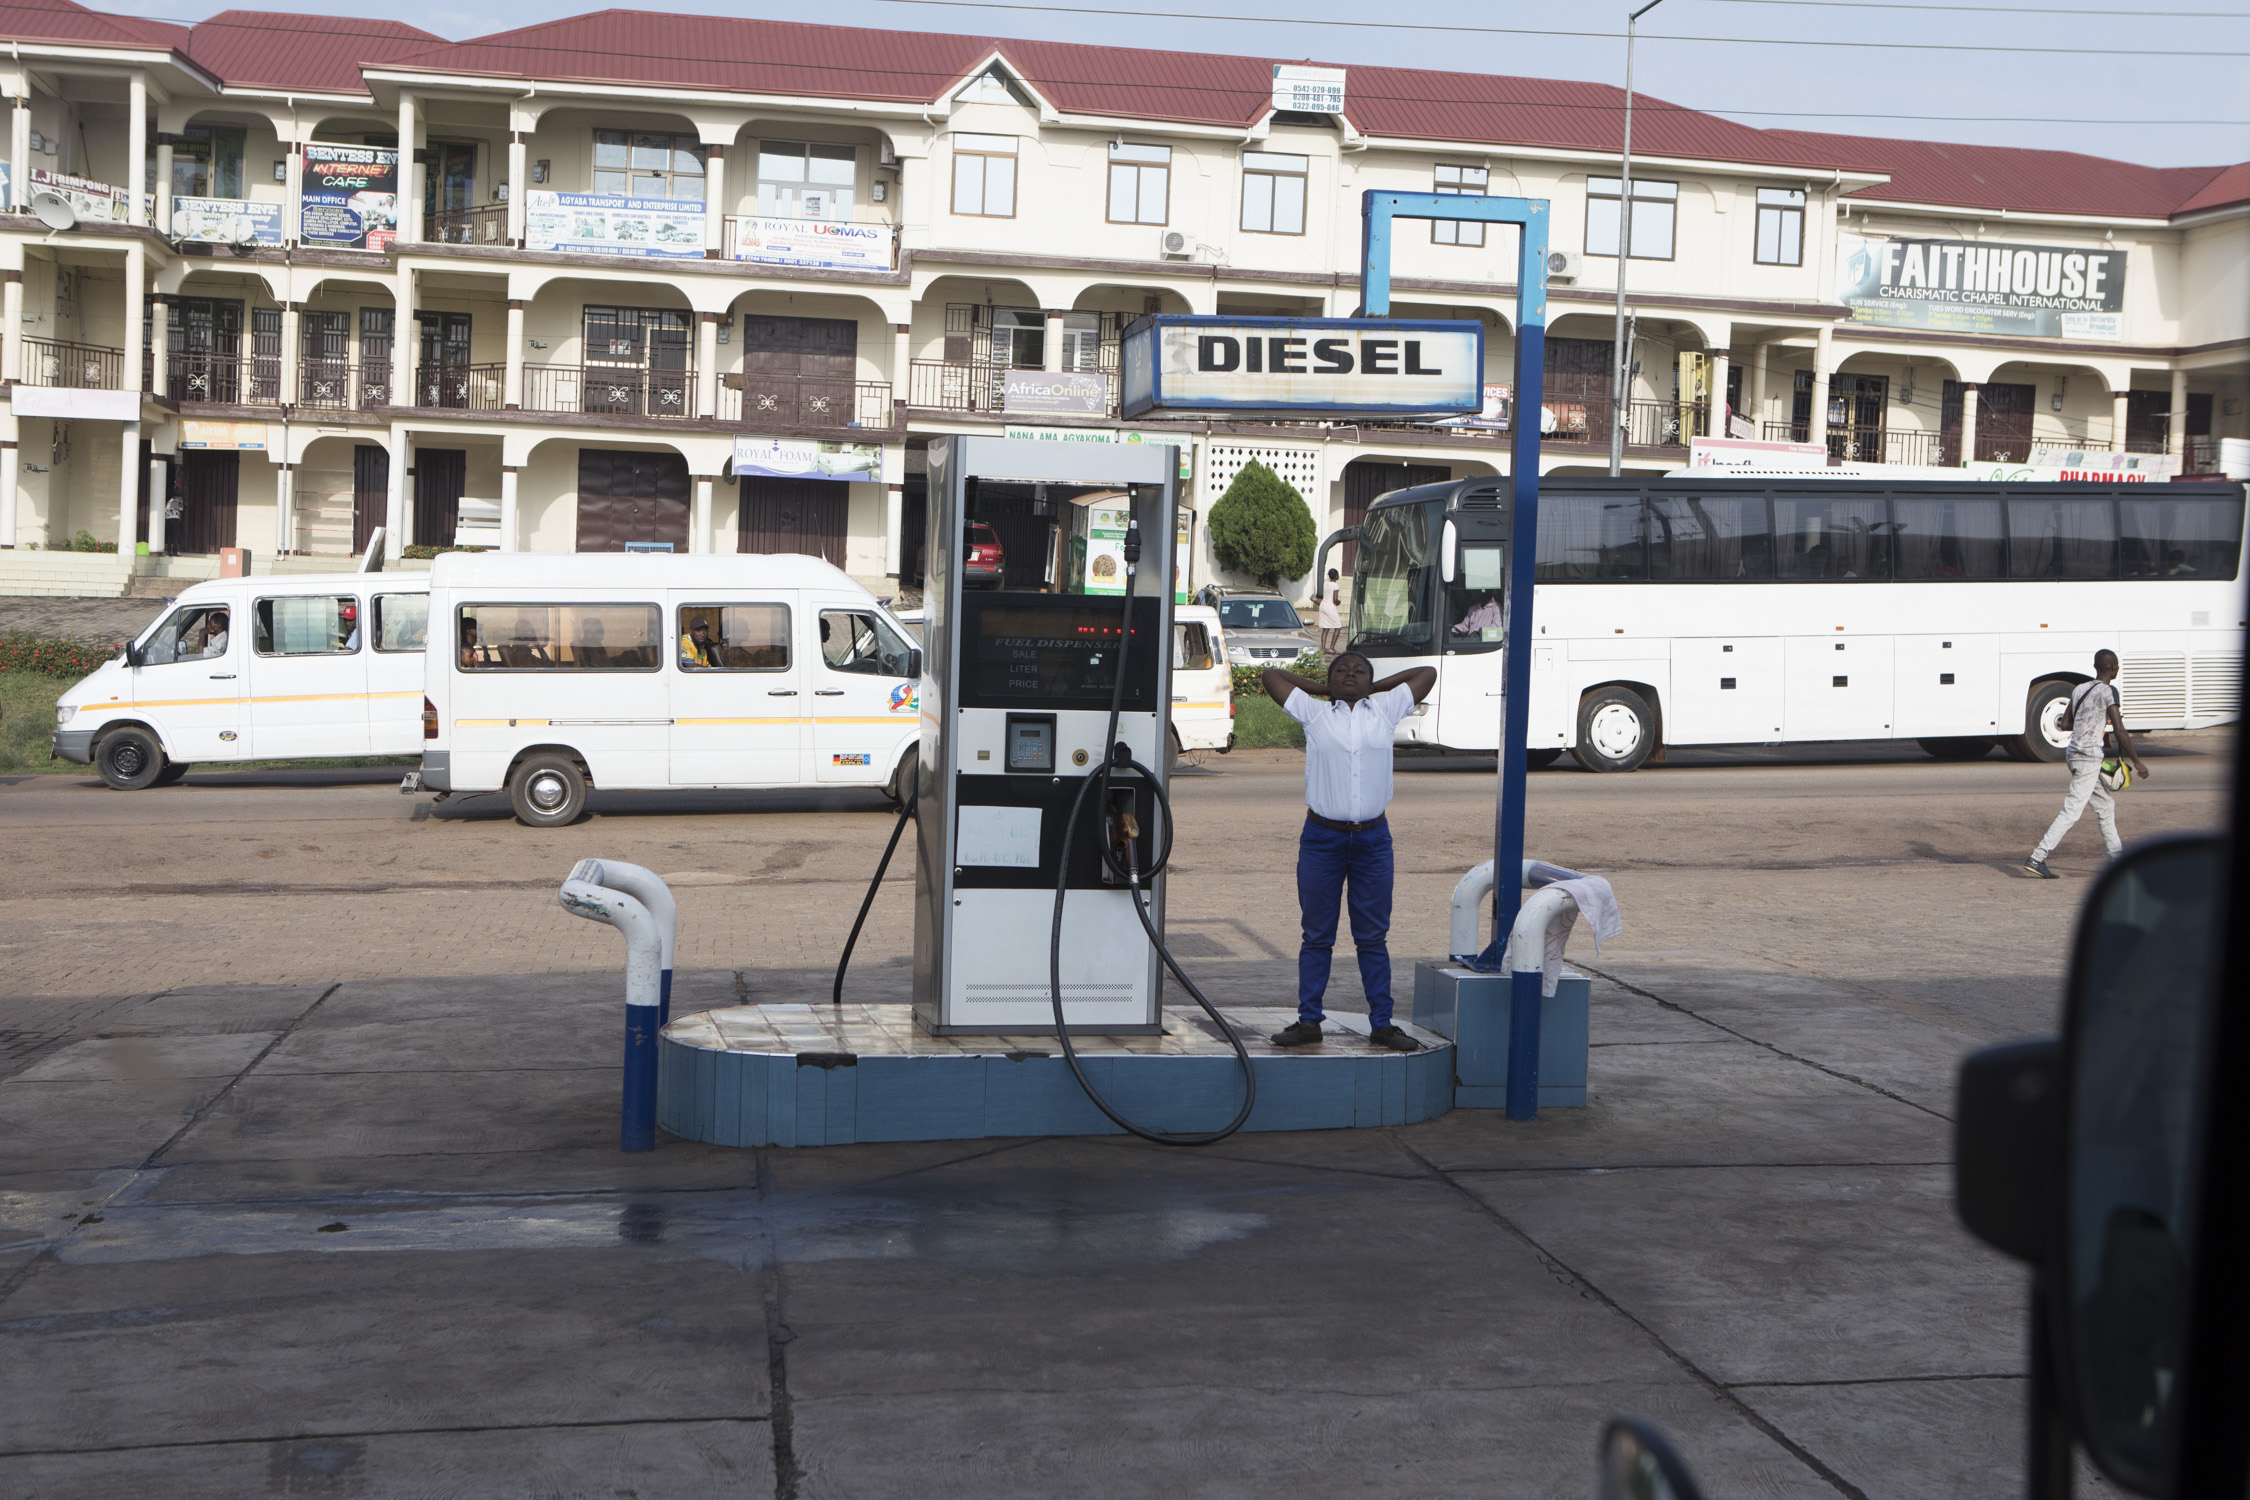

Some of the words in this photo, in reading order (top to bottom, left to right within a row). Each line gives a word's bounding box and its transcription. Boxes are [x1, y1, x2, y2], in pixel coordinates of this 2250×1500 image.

[306, 146, 374, 163] BENTESS
[313, 163, 393, 176] INTERNET
[52, 173, 110, 194] FRIMPONG
[322, 176, 369, 188] CAFE
[178, 198, 245, 214] BENTESS
[302, 194, 320, 204] MAIN
[321, 196, 346, 205] OFFICE
[561, 196, 588, 205] AGYABA
[589, 197, 625, 209] TRANSPORT
[628, 199, 642, 209] AND
[643, 201, 677, 211] ENTERPRISE
[679, 203, 702, 212] LIMITED
[765, 221, 808, 234] ROYAL
[1880, 242, 2110, 300] FAITHHOUSE
[1863, 299, 1889, 308] SERVICE
[1880, 285, 1959, 302] CHARISMATIC
[1961, 290, 2007, 305] CHAPEL
[2009, 294, 2104, 312] INTERNATIONAL
[1944, 305, 1964, 313] WORD
[1965, 307, 2002, 317] ENCOUNTER
[1197, 335, 1442, 376] DIESEL
[1008, 382, 1099, 398] AfricaOnline
[200, 425, 227, 436] airtel
[1009, 431, 1034, 440] NANA
[1039, 432, 1058, 440] AMA
[1063, 433, 1111, 443] AGYAKOMA
[737, 448, 773, 460] ROYAL
[779, 450, 812, 462] FOAM
[994, 638, 1034, 647] FUEL
[1036, 639, 1121, 650] DISPENSER
[1012, 650, 1037, 659] SALE
[1010, 665, 1038, 674] LITER
[1009, 680, 1039, 689] PRICE
